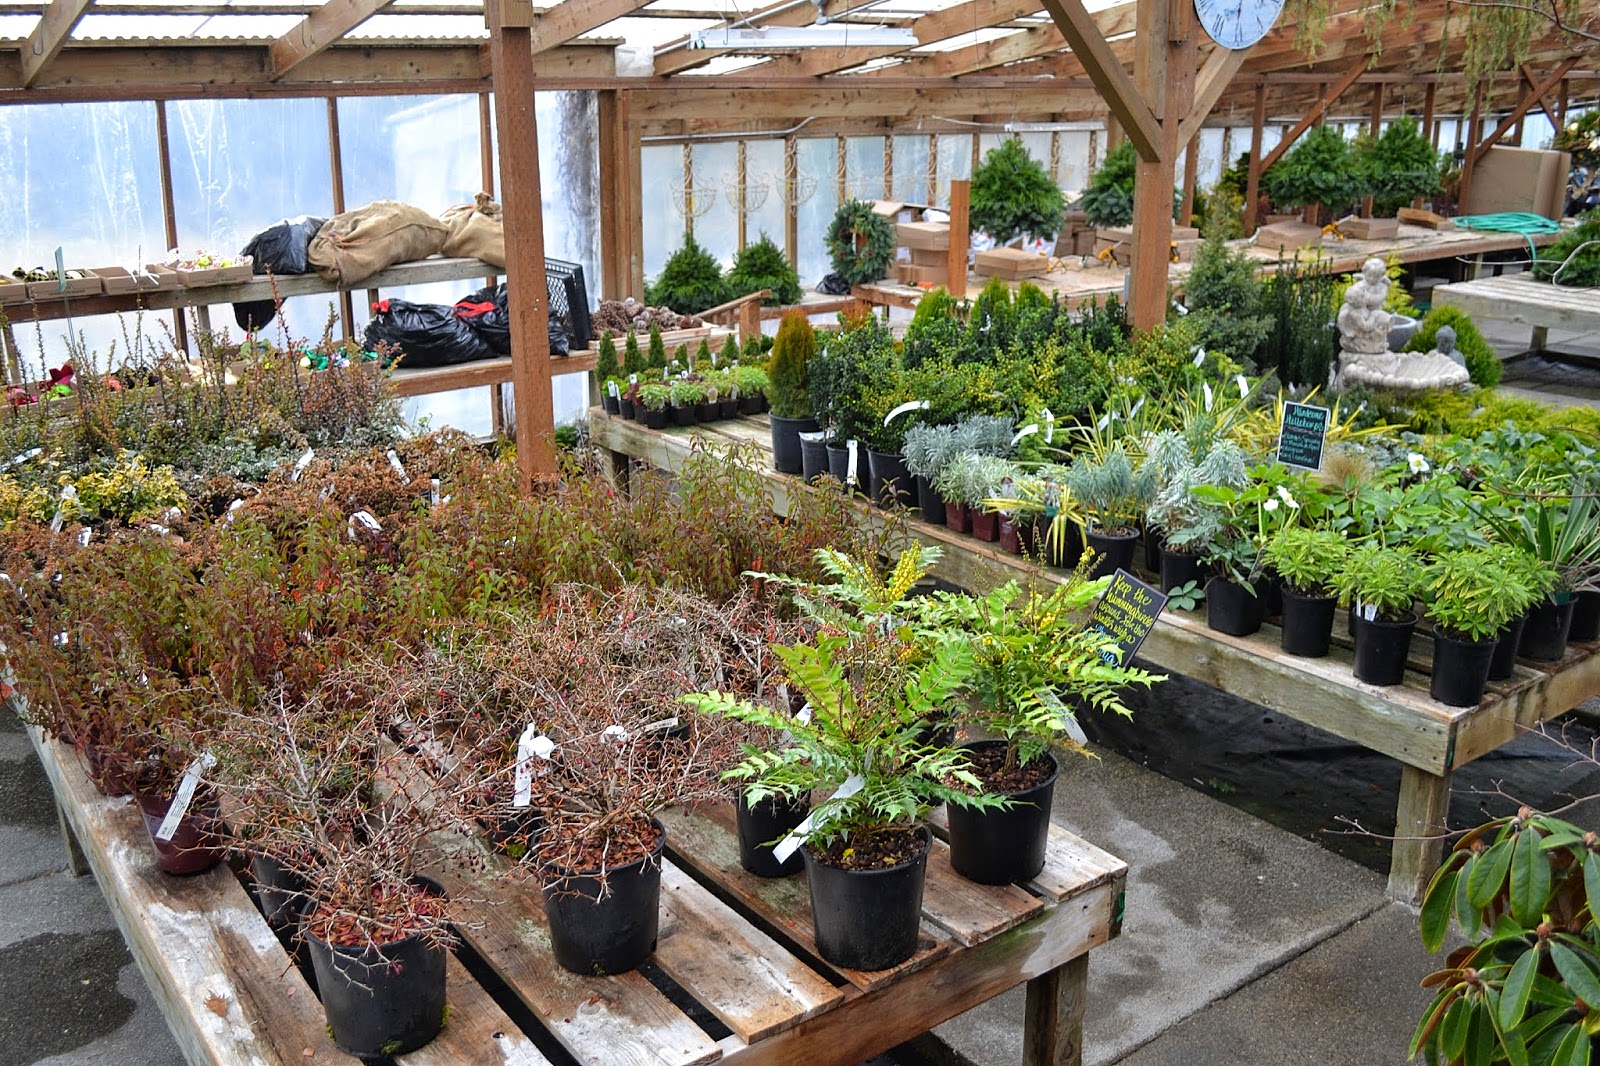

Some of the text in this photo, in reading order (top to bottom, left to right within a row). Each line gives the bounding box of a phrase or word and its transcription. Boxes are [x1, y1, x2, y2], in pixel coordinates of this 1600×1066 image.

[1106, 587, 1153, 628] hummingbirds
[1114, 574, 1152, 606] Keep the
[1098, 600, 1121, 620] around
[1133, 622, 1145, 638] the
[1126, 634, 1136, 644] a
